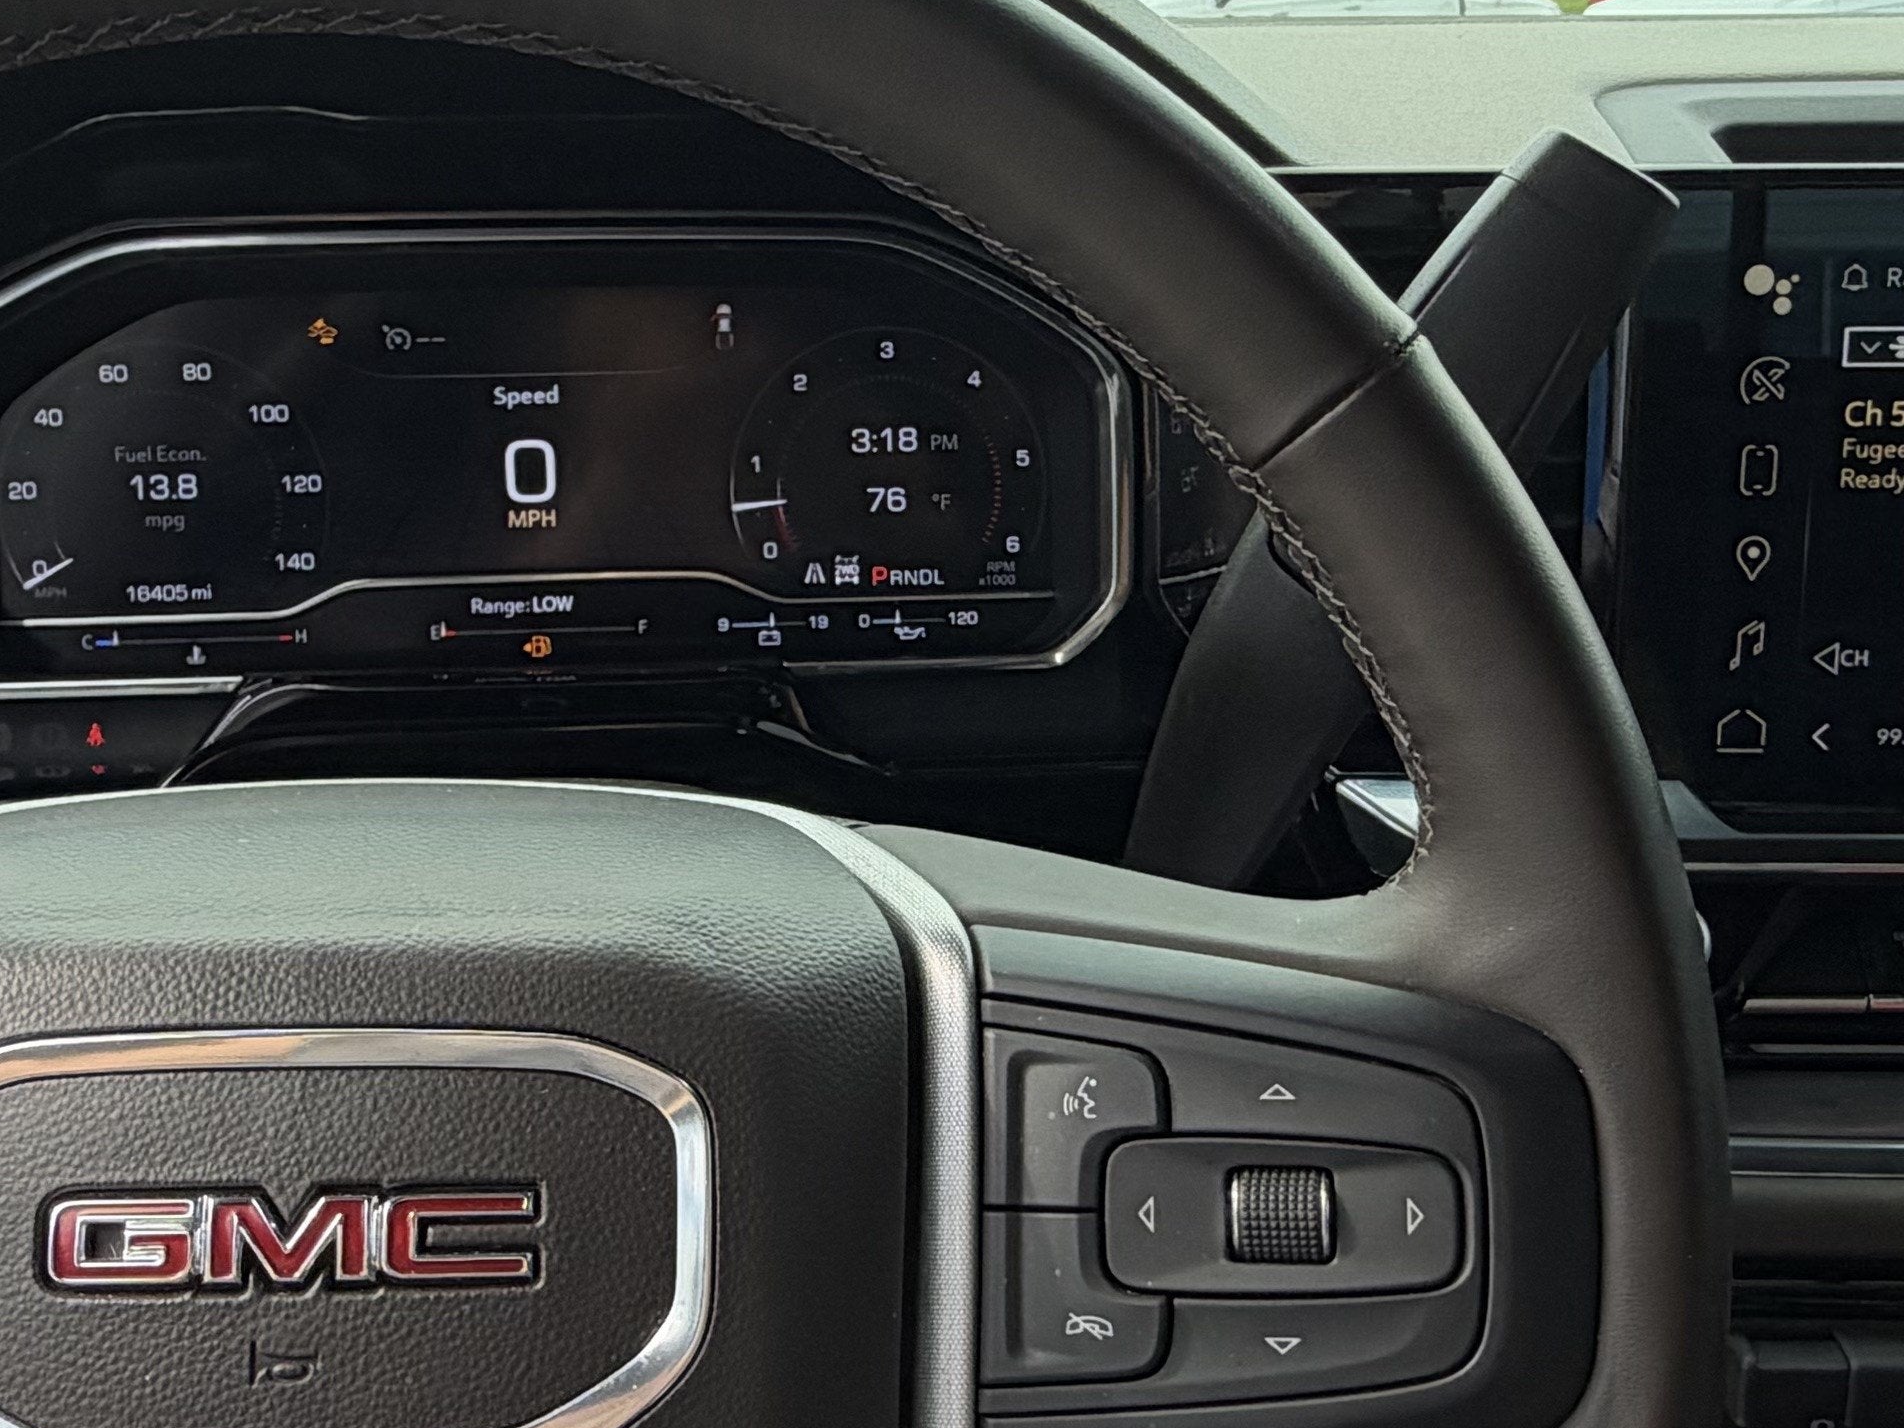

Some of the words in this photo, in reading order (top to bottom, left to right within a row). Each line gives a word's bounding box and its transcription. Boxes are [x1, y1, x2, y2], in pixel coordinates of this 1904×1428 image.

[878, 341, 896, 360] 3
[99, 363, 130, 384] 60
[181, 363, 212, 383] 80
[792, 373, 809, 392] 2
[966, 370, 983, 388] 4
[492, 384, 561, 409] Speed
[33, 407, 64, 428] 40
[248, 403, 290, 424] 100
[1843, 400, 1884, 429] Ch
[849, 426, 920, 454] 3:18
[930, 433, 959, 452] PM
[113, 444, 153, 465] Fuel
[156, 444, 208, 464] Econ.
[749, 454, 762, 473] 1
[1014, 449, 1031, 468] 5
[503, 438, 558, 506] 0
[7, 480, 38, 501] 20
[128, 473, 199, 501] 13.8
[280, 473, 323, 495] 120
[865, 486, 908, 514] 76
[143, 512, 186, 533] mpg
[507, 508, 559, 529] MPH
[762, 541, 779, 560] 0
[1005, 534, 1021, 554] 6
[274, 552, 316, 572] 140
[984, 560, 1017, 574] RPM
[190, 583, 214, 601] mi
[470, 595, 532, 616] Range:
[532, 594, 575, 614] LOW
[636, 619, 649, 635] F
[857, 612, 872, 630] 0
[947, 610, 980, 628] 120
[80, 634, 95, 651] C
[294, 628, 308, 644] H
[430, 624, 442, 641] E
[1840, 648, 1871, 668] CH
[46, 1188, 536, 1288] GMC
